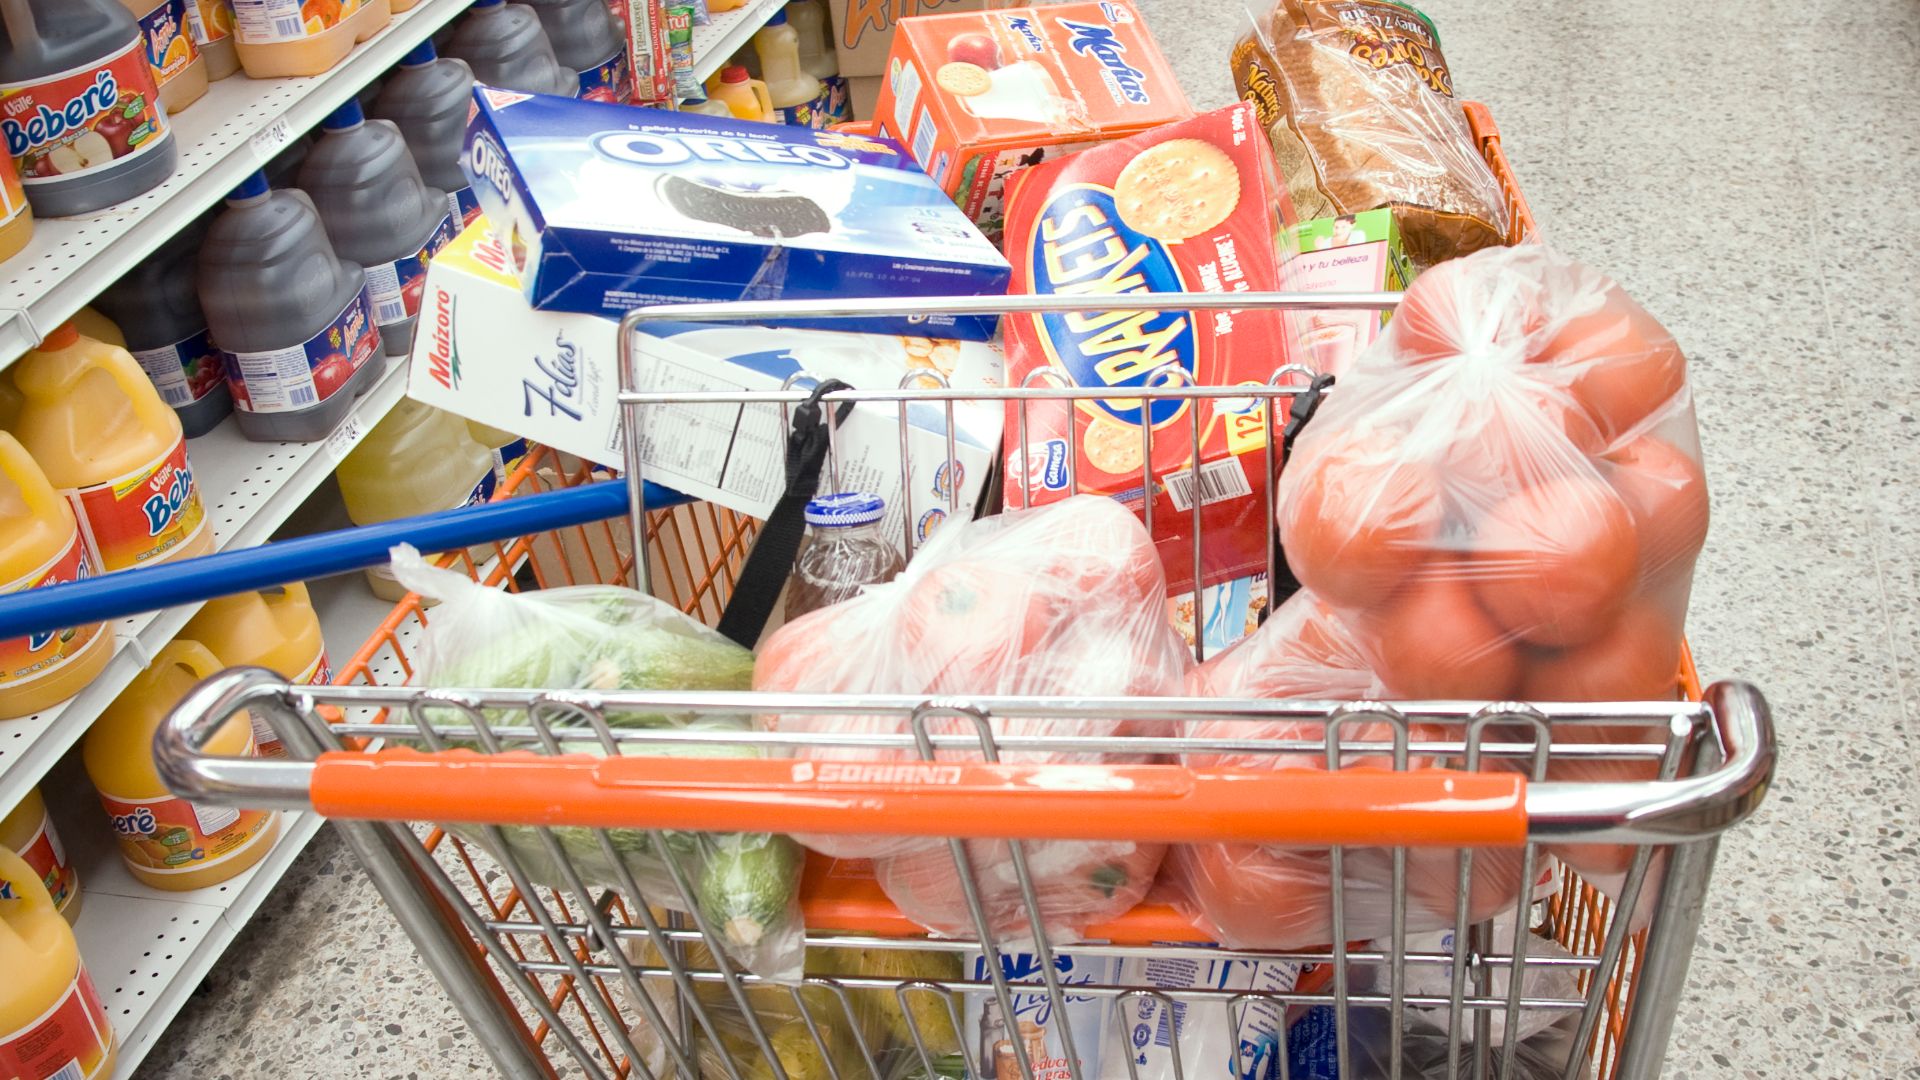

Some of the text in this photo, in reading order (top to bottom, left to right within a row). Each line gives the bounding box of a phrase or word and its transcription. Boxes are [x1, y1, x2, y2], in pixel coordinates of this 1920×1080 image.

[1, 70, 117, 157] Beberé
[472, 134, 512, 201] OREO
[600, 133, 850, 170] OREO
[429, 290, 451, 391] Maizoro
[1237, 411, 1266, 440] 12
